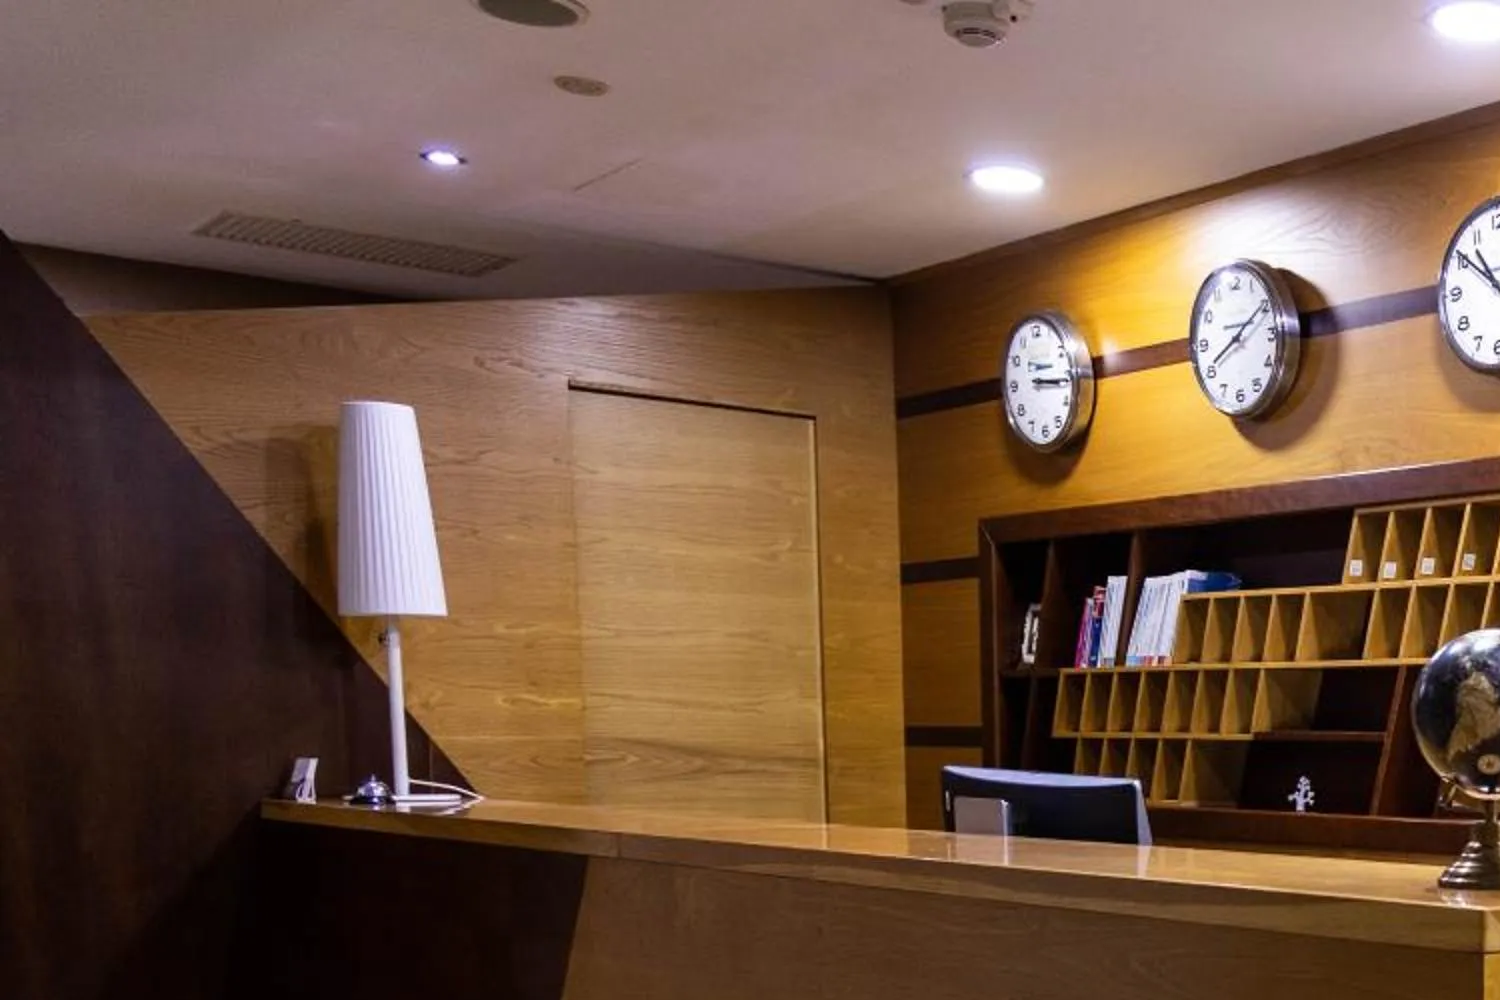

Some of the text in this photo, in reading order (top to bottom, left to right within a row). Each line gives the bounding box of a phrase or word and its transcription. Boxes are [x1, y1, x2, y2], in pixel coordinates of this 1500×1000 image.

[1473, 230, 1481, 245] 11
[1450, 287, 1462, 302] 9
[1457, 316, 1470, 331] 8
[1268, 327, 1275, 342] 3
[1200, 340, 1208, 352] 9
[1473, 336, 1483, 351] 7
[1264, 355, 1272, 367] 4
[1206, 366, 1216, 379] 8
[1220, 384, 1228, 397] 7
[1252, 378, 1262, 392] 5
[1236, 390, 1245, 402] 6
